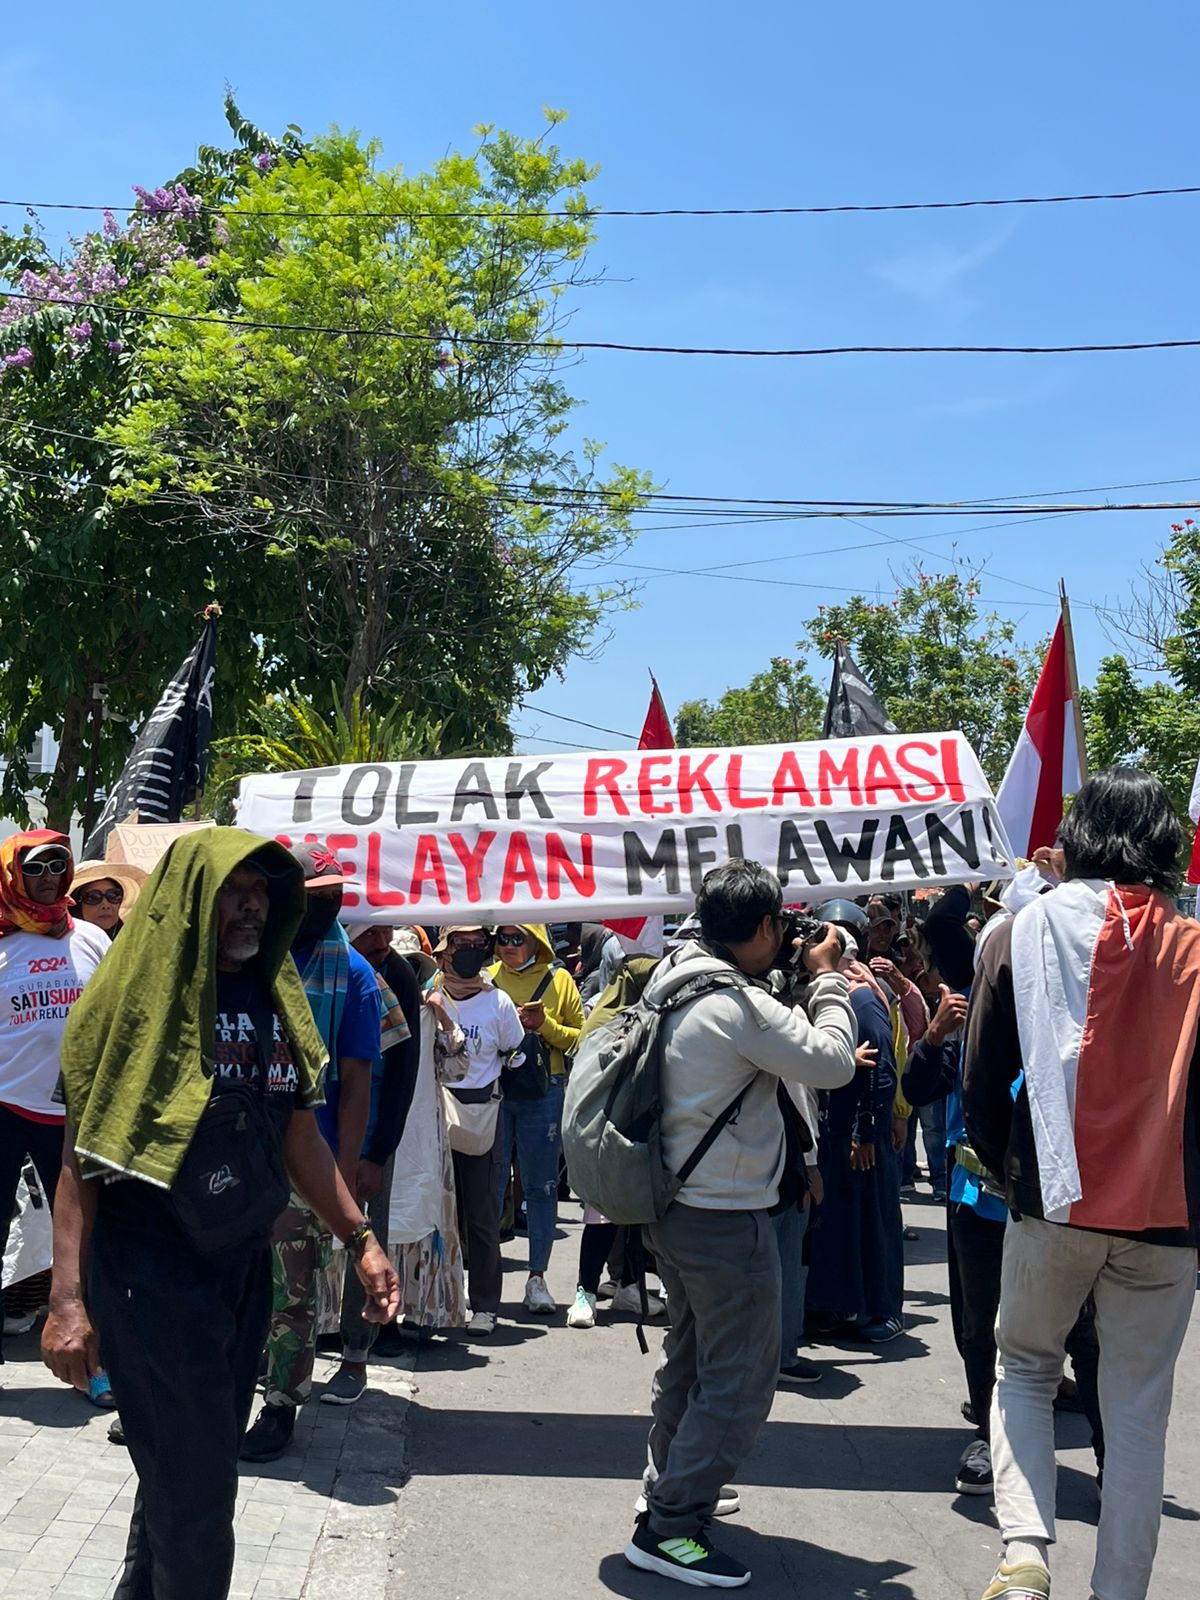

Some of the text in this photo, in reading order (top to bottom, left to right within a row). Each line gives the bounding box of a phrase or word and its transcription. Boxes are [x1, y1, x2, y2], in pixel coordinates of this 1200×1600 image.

[282, 738, 966, 829] TOLAK REKLAMASI
[121, 829, 170, 847] DUIT
[275, 831, 597, 907] ELAYAN
[18, 979, 84, 993] SURABAYA
[9, 1009, 38, 1026] TOLAK
